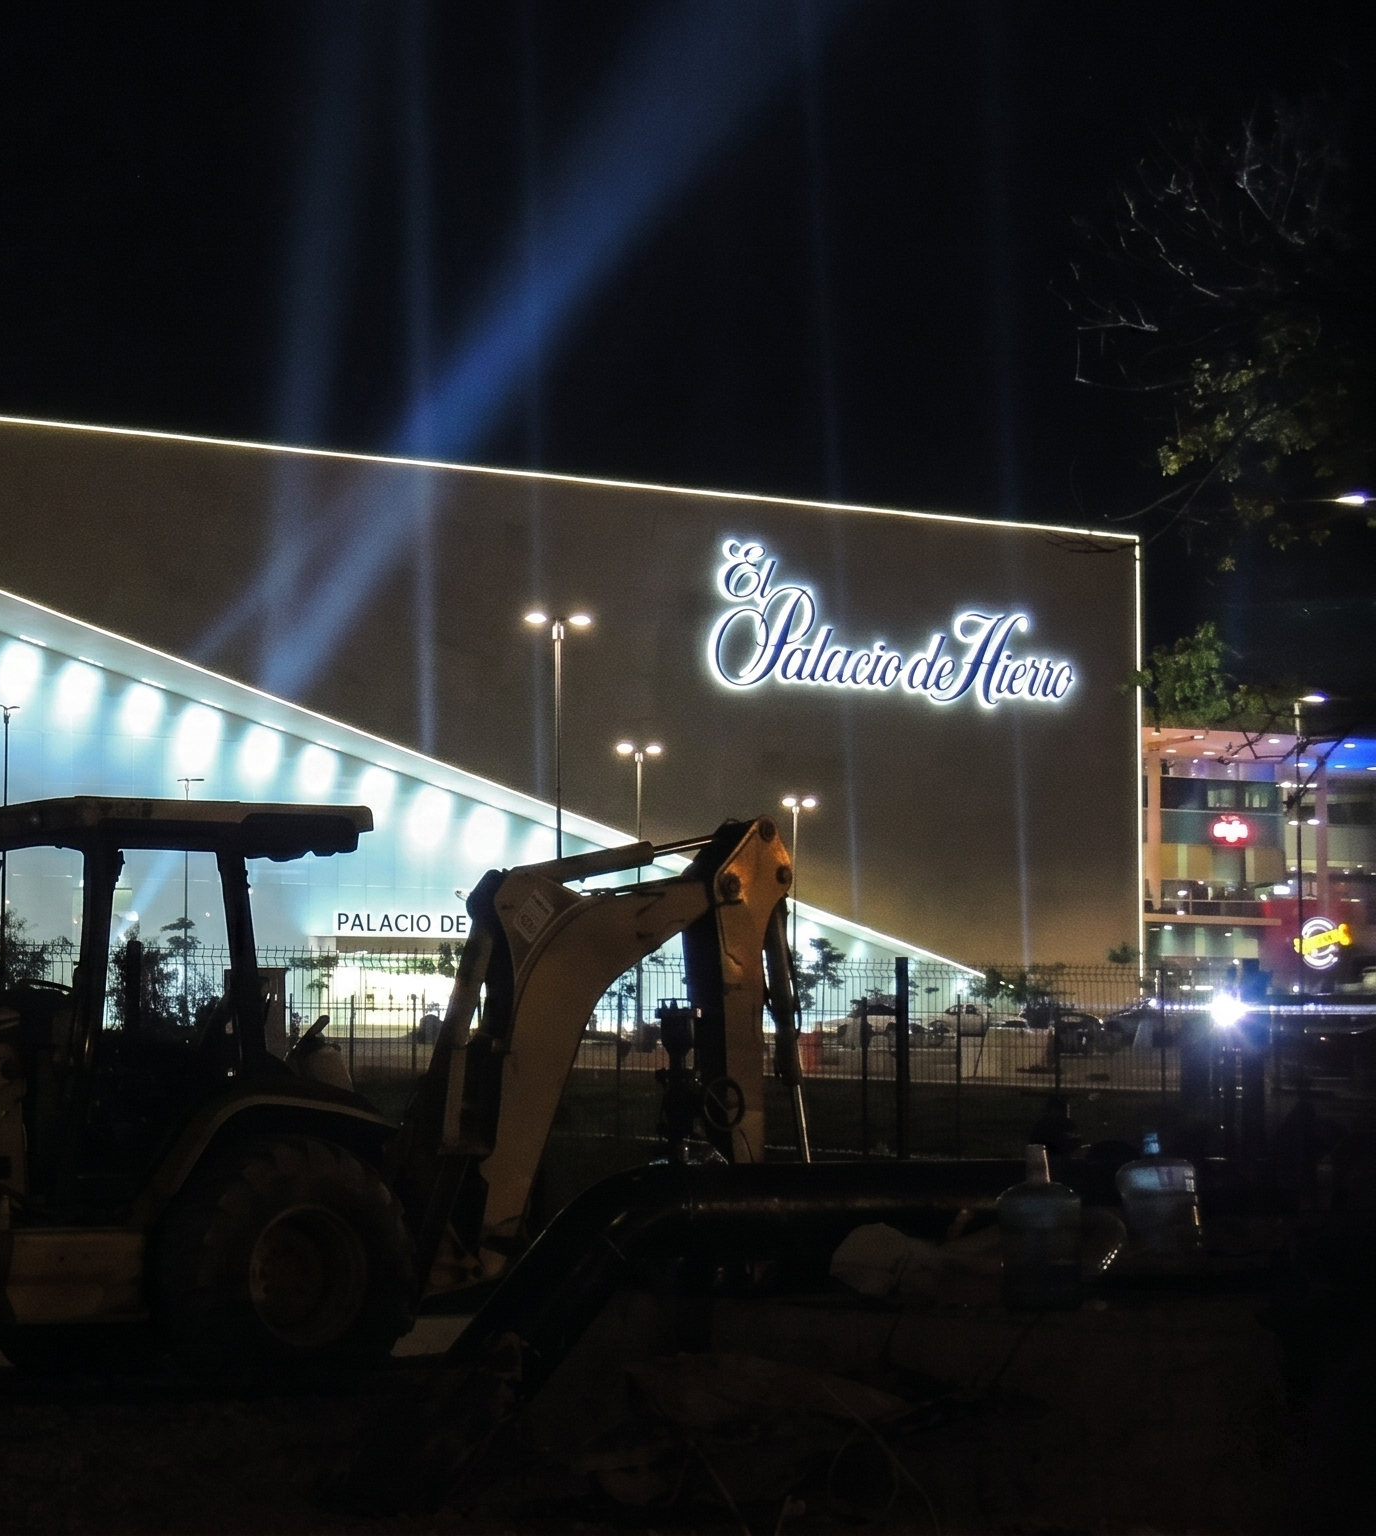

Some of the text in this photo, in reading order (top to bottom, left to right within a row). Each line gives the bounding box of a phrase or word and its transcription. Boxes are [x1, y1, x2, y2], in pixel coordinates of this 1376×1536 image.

[721, 538, 777, 599] El
[712, 585, 1074, 705] Palacio de Hierro
[337, 912, 467, 933] PALACIO DE
